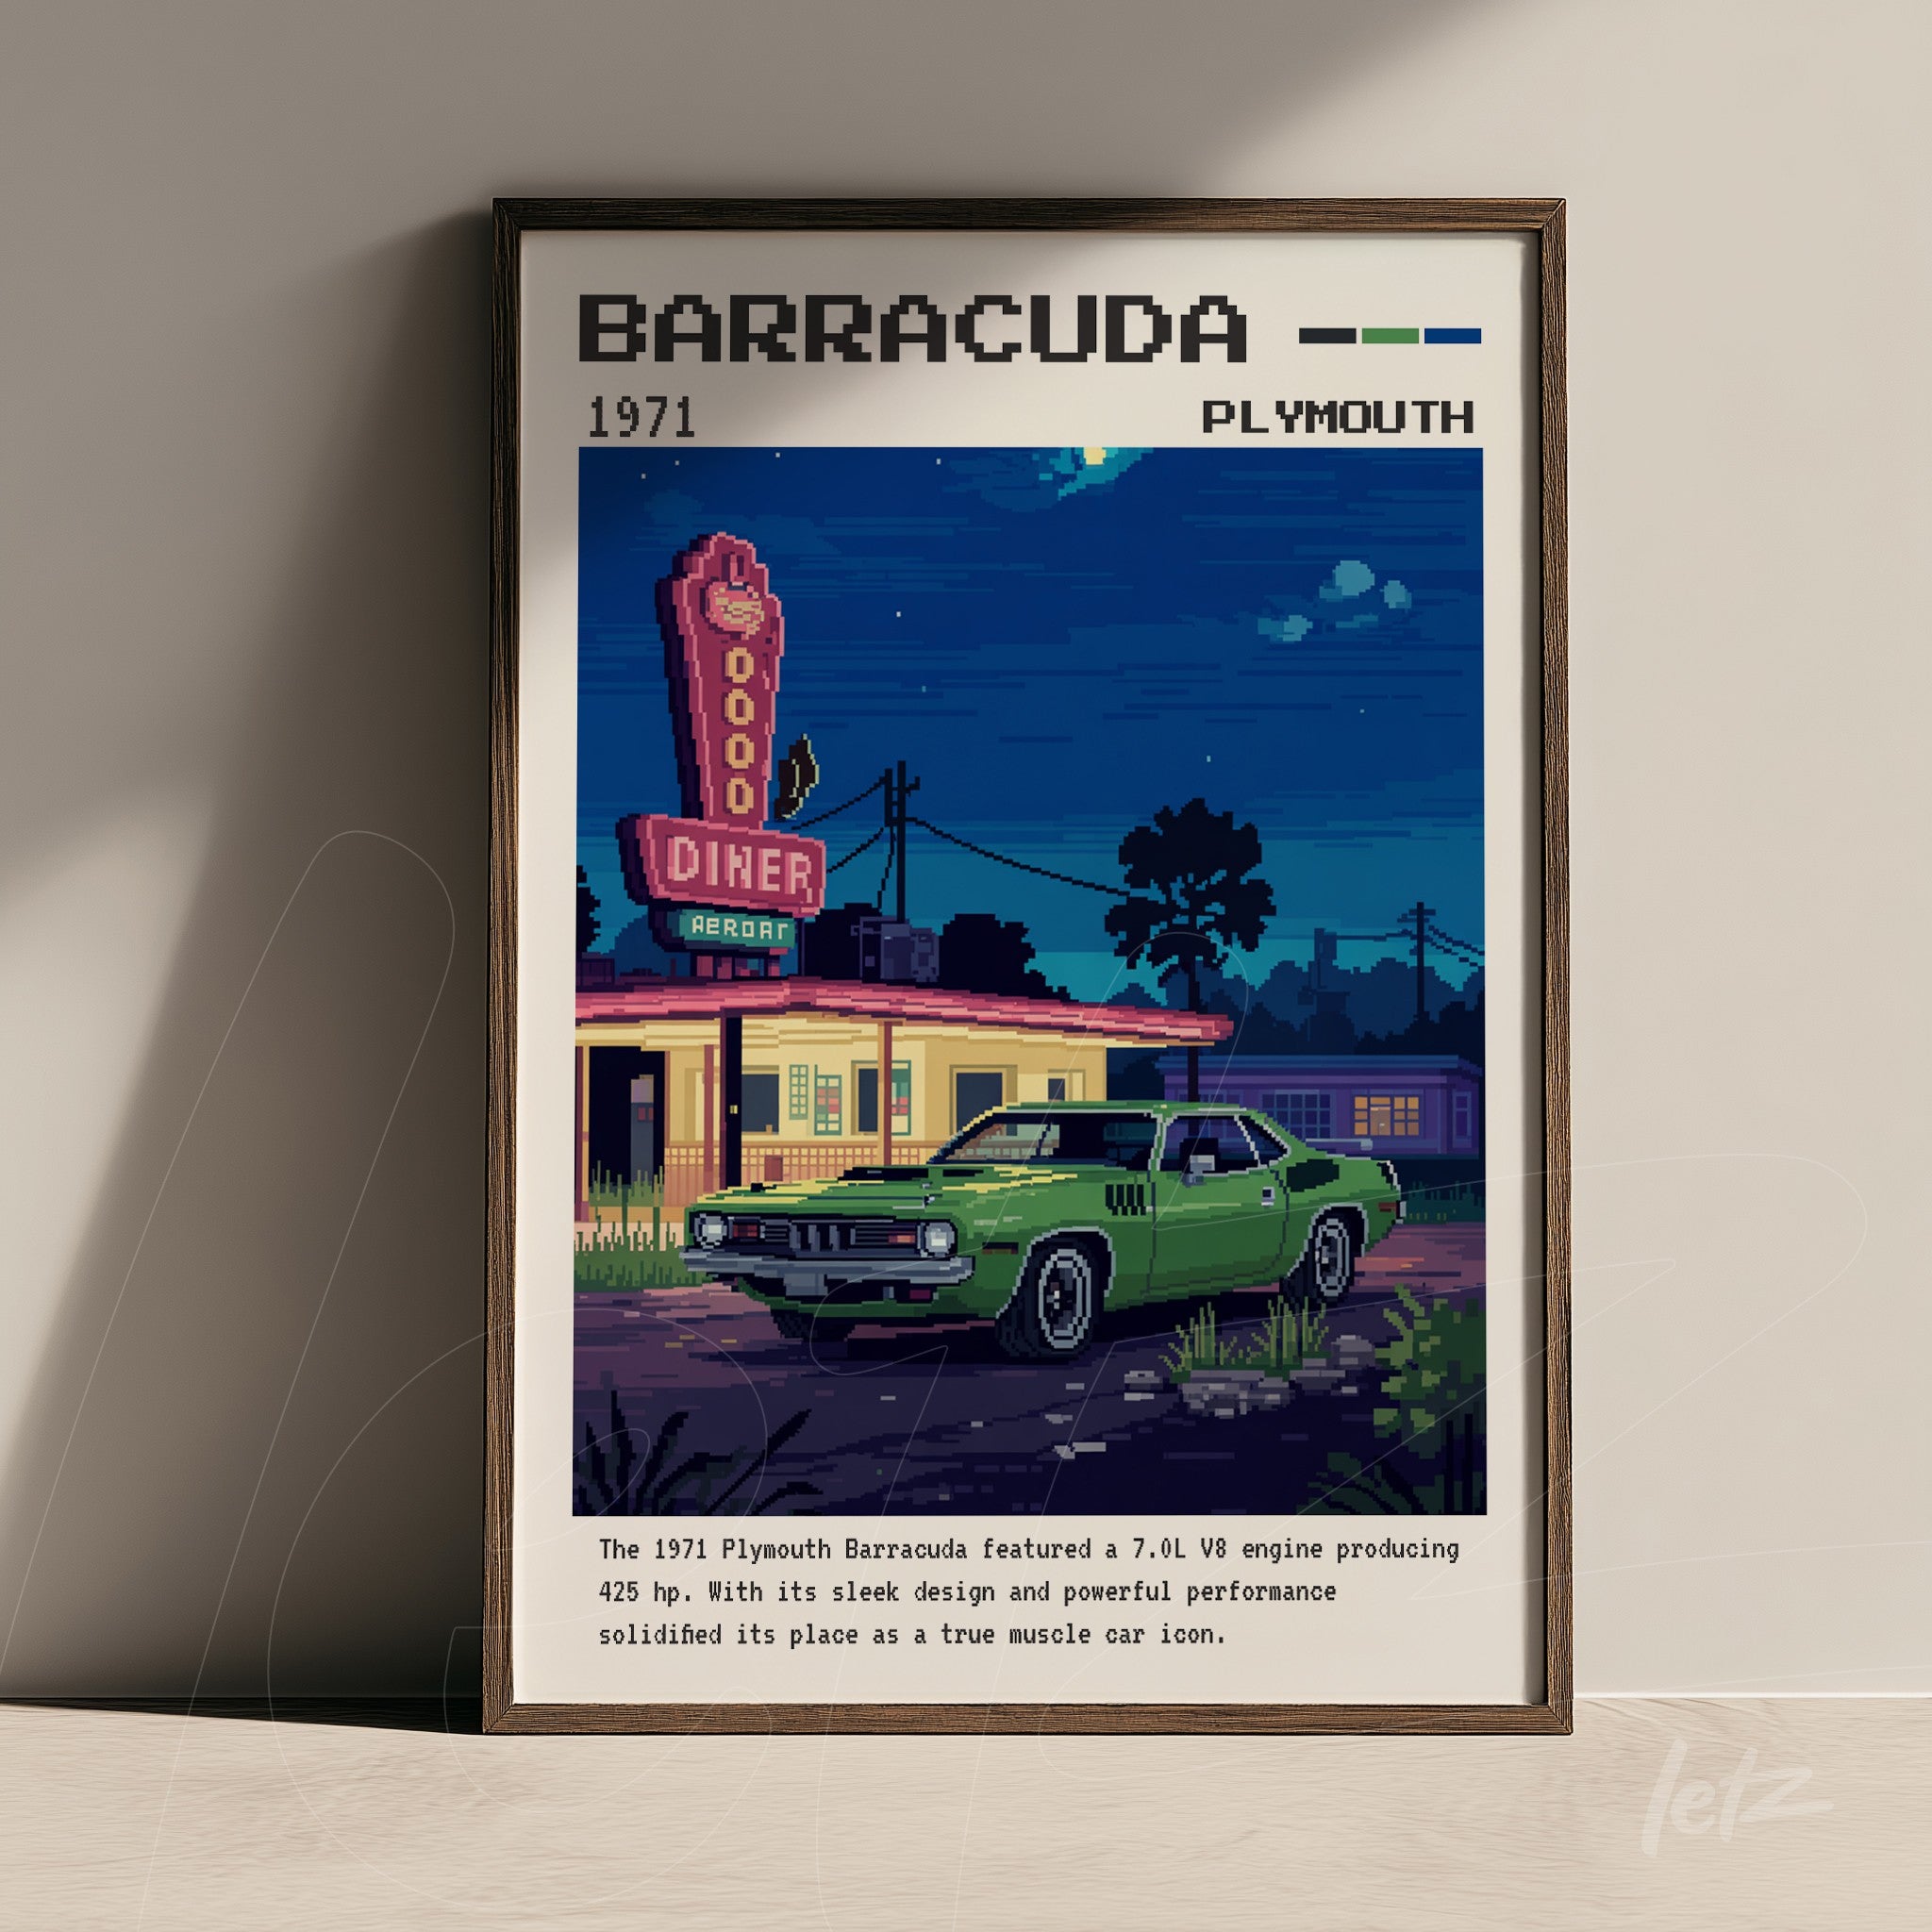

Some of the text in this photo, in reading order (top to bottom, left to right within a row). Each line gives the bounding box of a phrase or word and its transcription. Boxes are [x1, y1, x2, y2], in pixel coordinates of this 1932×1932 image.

[578, 294, 1247, 363] BARRACUDA
[590, 395, 695, 438] 1971
[1203, 400, 1474, 434] PLYMOUTH
[667, 836, 813, 903] DINER
[599, 1537, 1459, 1565] The 1971 Plymouth Barracuda featured a 7.0L V8 engine producing
[598, 1580, 1337, 1607] 425 hp. With its sleek design and powerful performance
[599, 1623, 1225, 1650] solidified its place as a true muscle car icon.
